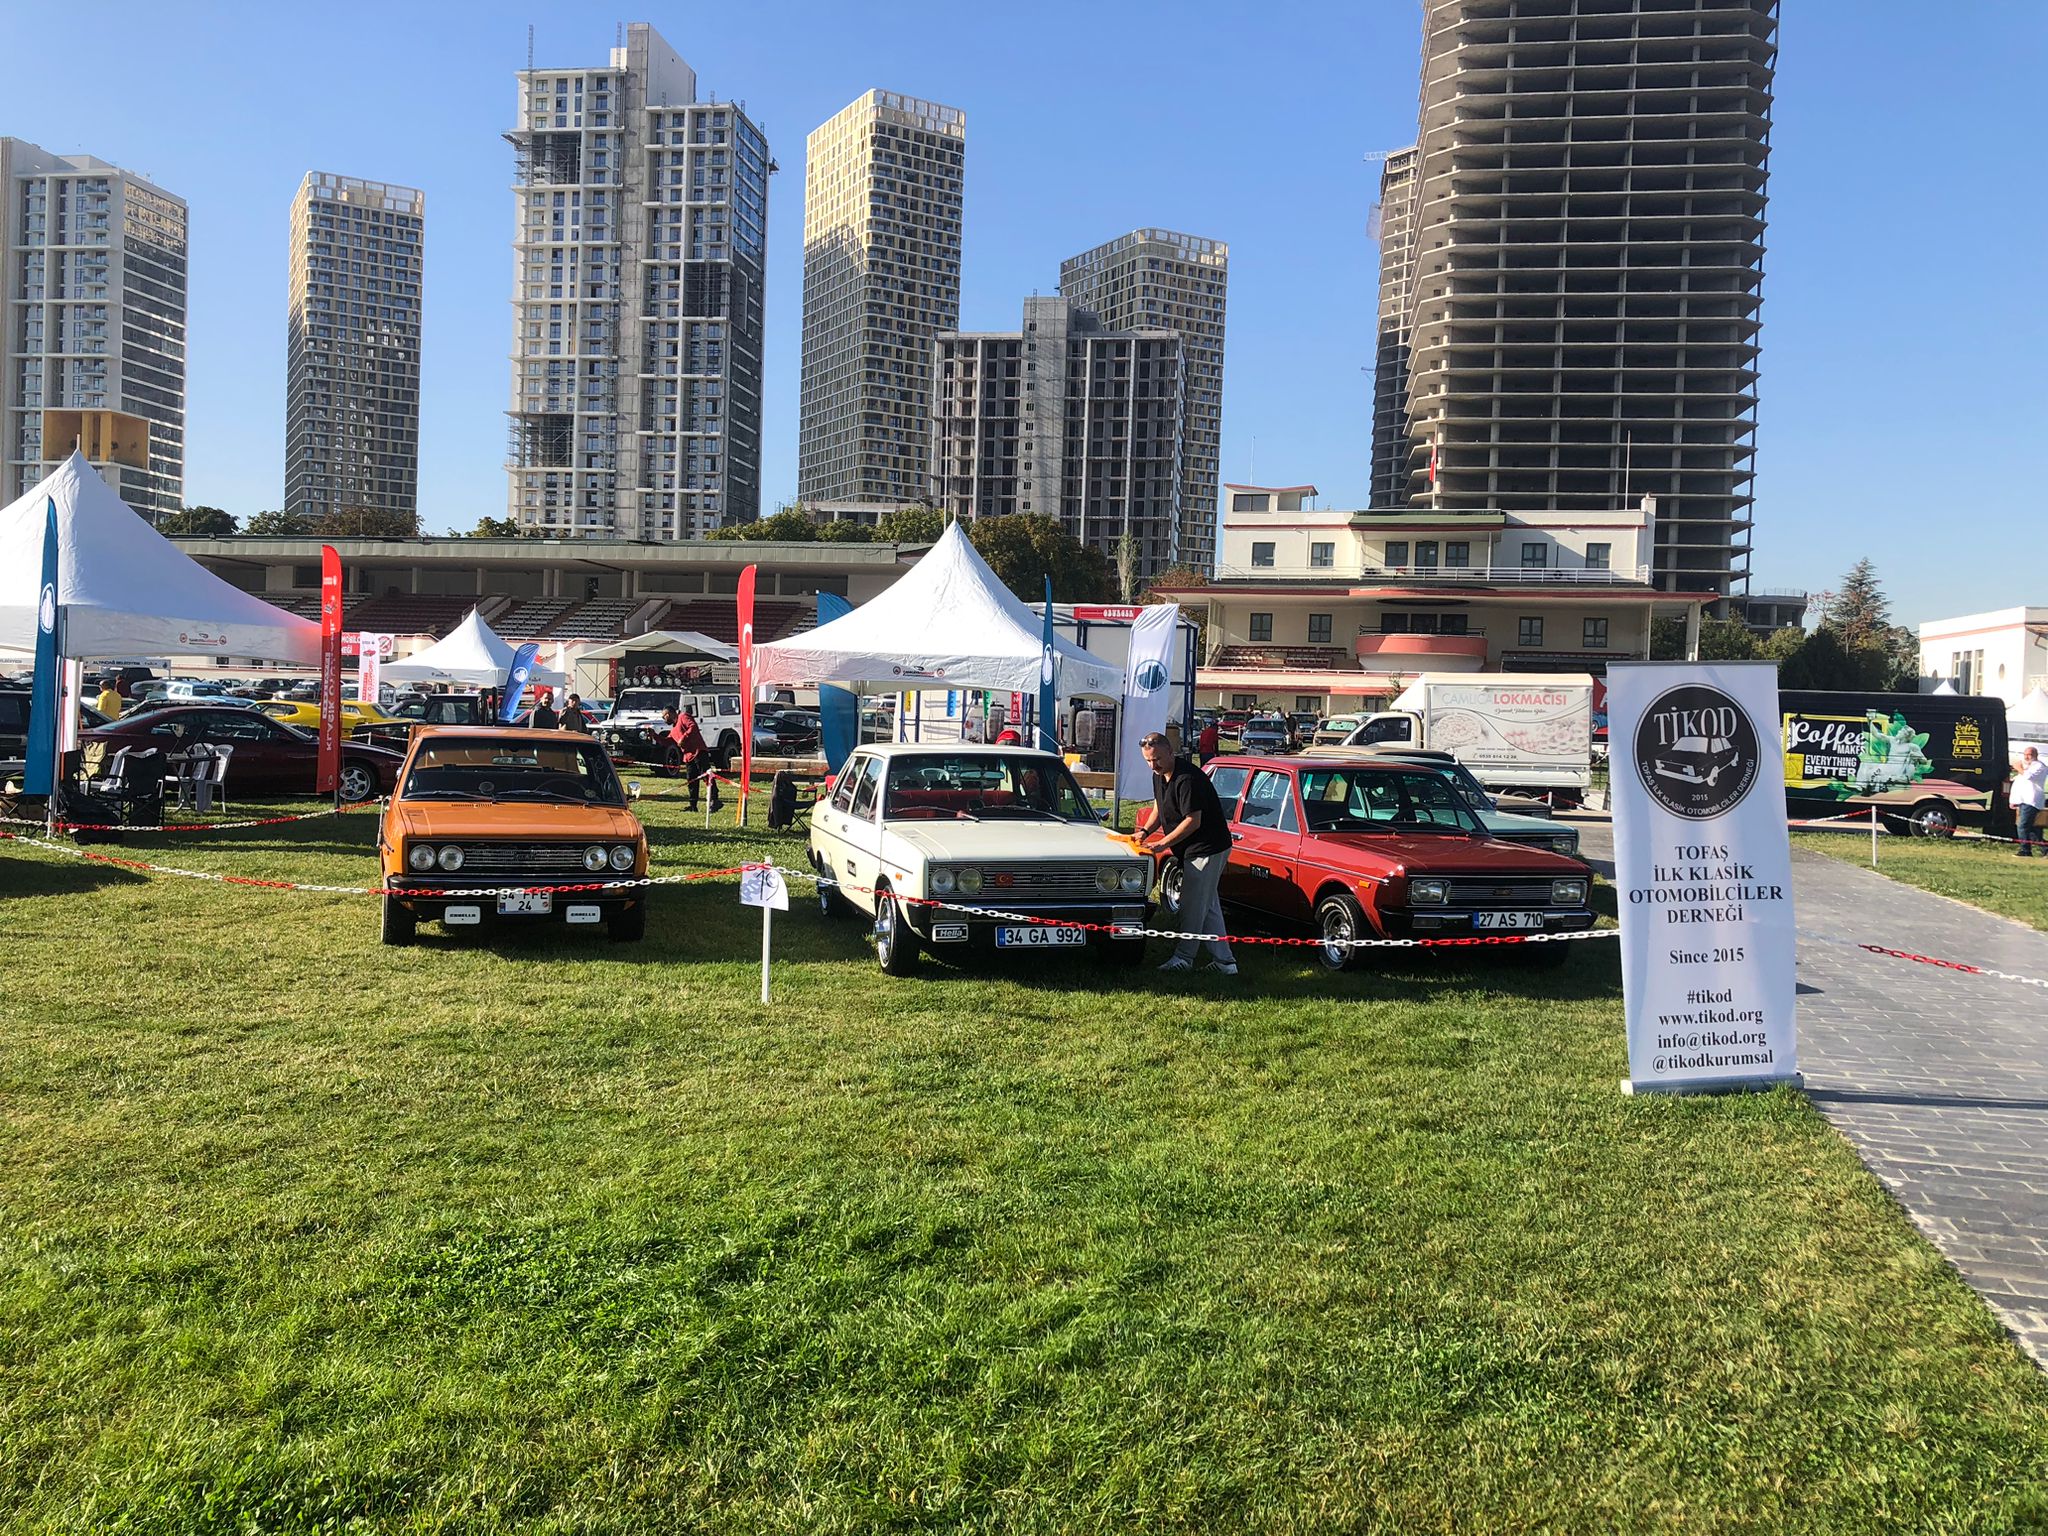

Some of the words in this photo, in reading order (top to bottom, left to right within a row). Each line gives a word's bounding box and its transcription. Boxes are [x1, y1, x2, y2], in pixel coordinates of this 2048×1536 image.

[1653, 706, 1738, 745] TİKOD
[1794, 721, 1865, 751] Coffee
[1837, 745, 1866, 755] MAKES
[1805, 755, 1857, 767] EVERYTHING
[1804, 766, 1857, 777] BETTER
[1692, 793, 1709, 801] 2015
[1674, 845, 1729, 862] TOFAŞ
[1654, 864, 1684, 882] İLK
[1689, 862, 1754, 881] KLASİK
[1629, 883, 1784, 904] OTOMOBİLCİLER
[518, 901, 532, 911] 24
[1667, 903, 1744, 924] DERNEĞİ
[1479, 913, 1494, 927] 27
[1498, 913, 1517, 927] AS
[1523, 913, 1543, 927] 710
[1005, 929, 1023, 944] 34
[1029, 928, 1049, 943] GA
[1056, 928, 1082, 942] 992
[1669, 950, 1709, 964] Since
[1713, 948, 1745, 963] 2015
[1687, 988, 1733, 1005] #tikod
[1658, 1008, 1764, 1026] www.tikod.org
[1658, 1031, 1767, 1051] info@tikod.org
[1652, 1049, 1774, 1074] @tikodkurumsal
